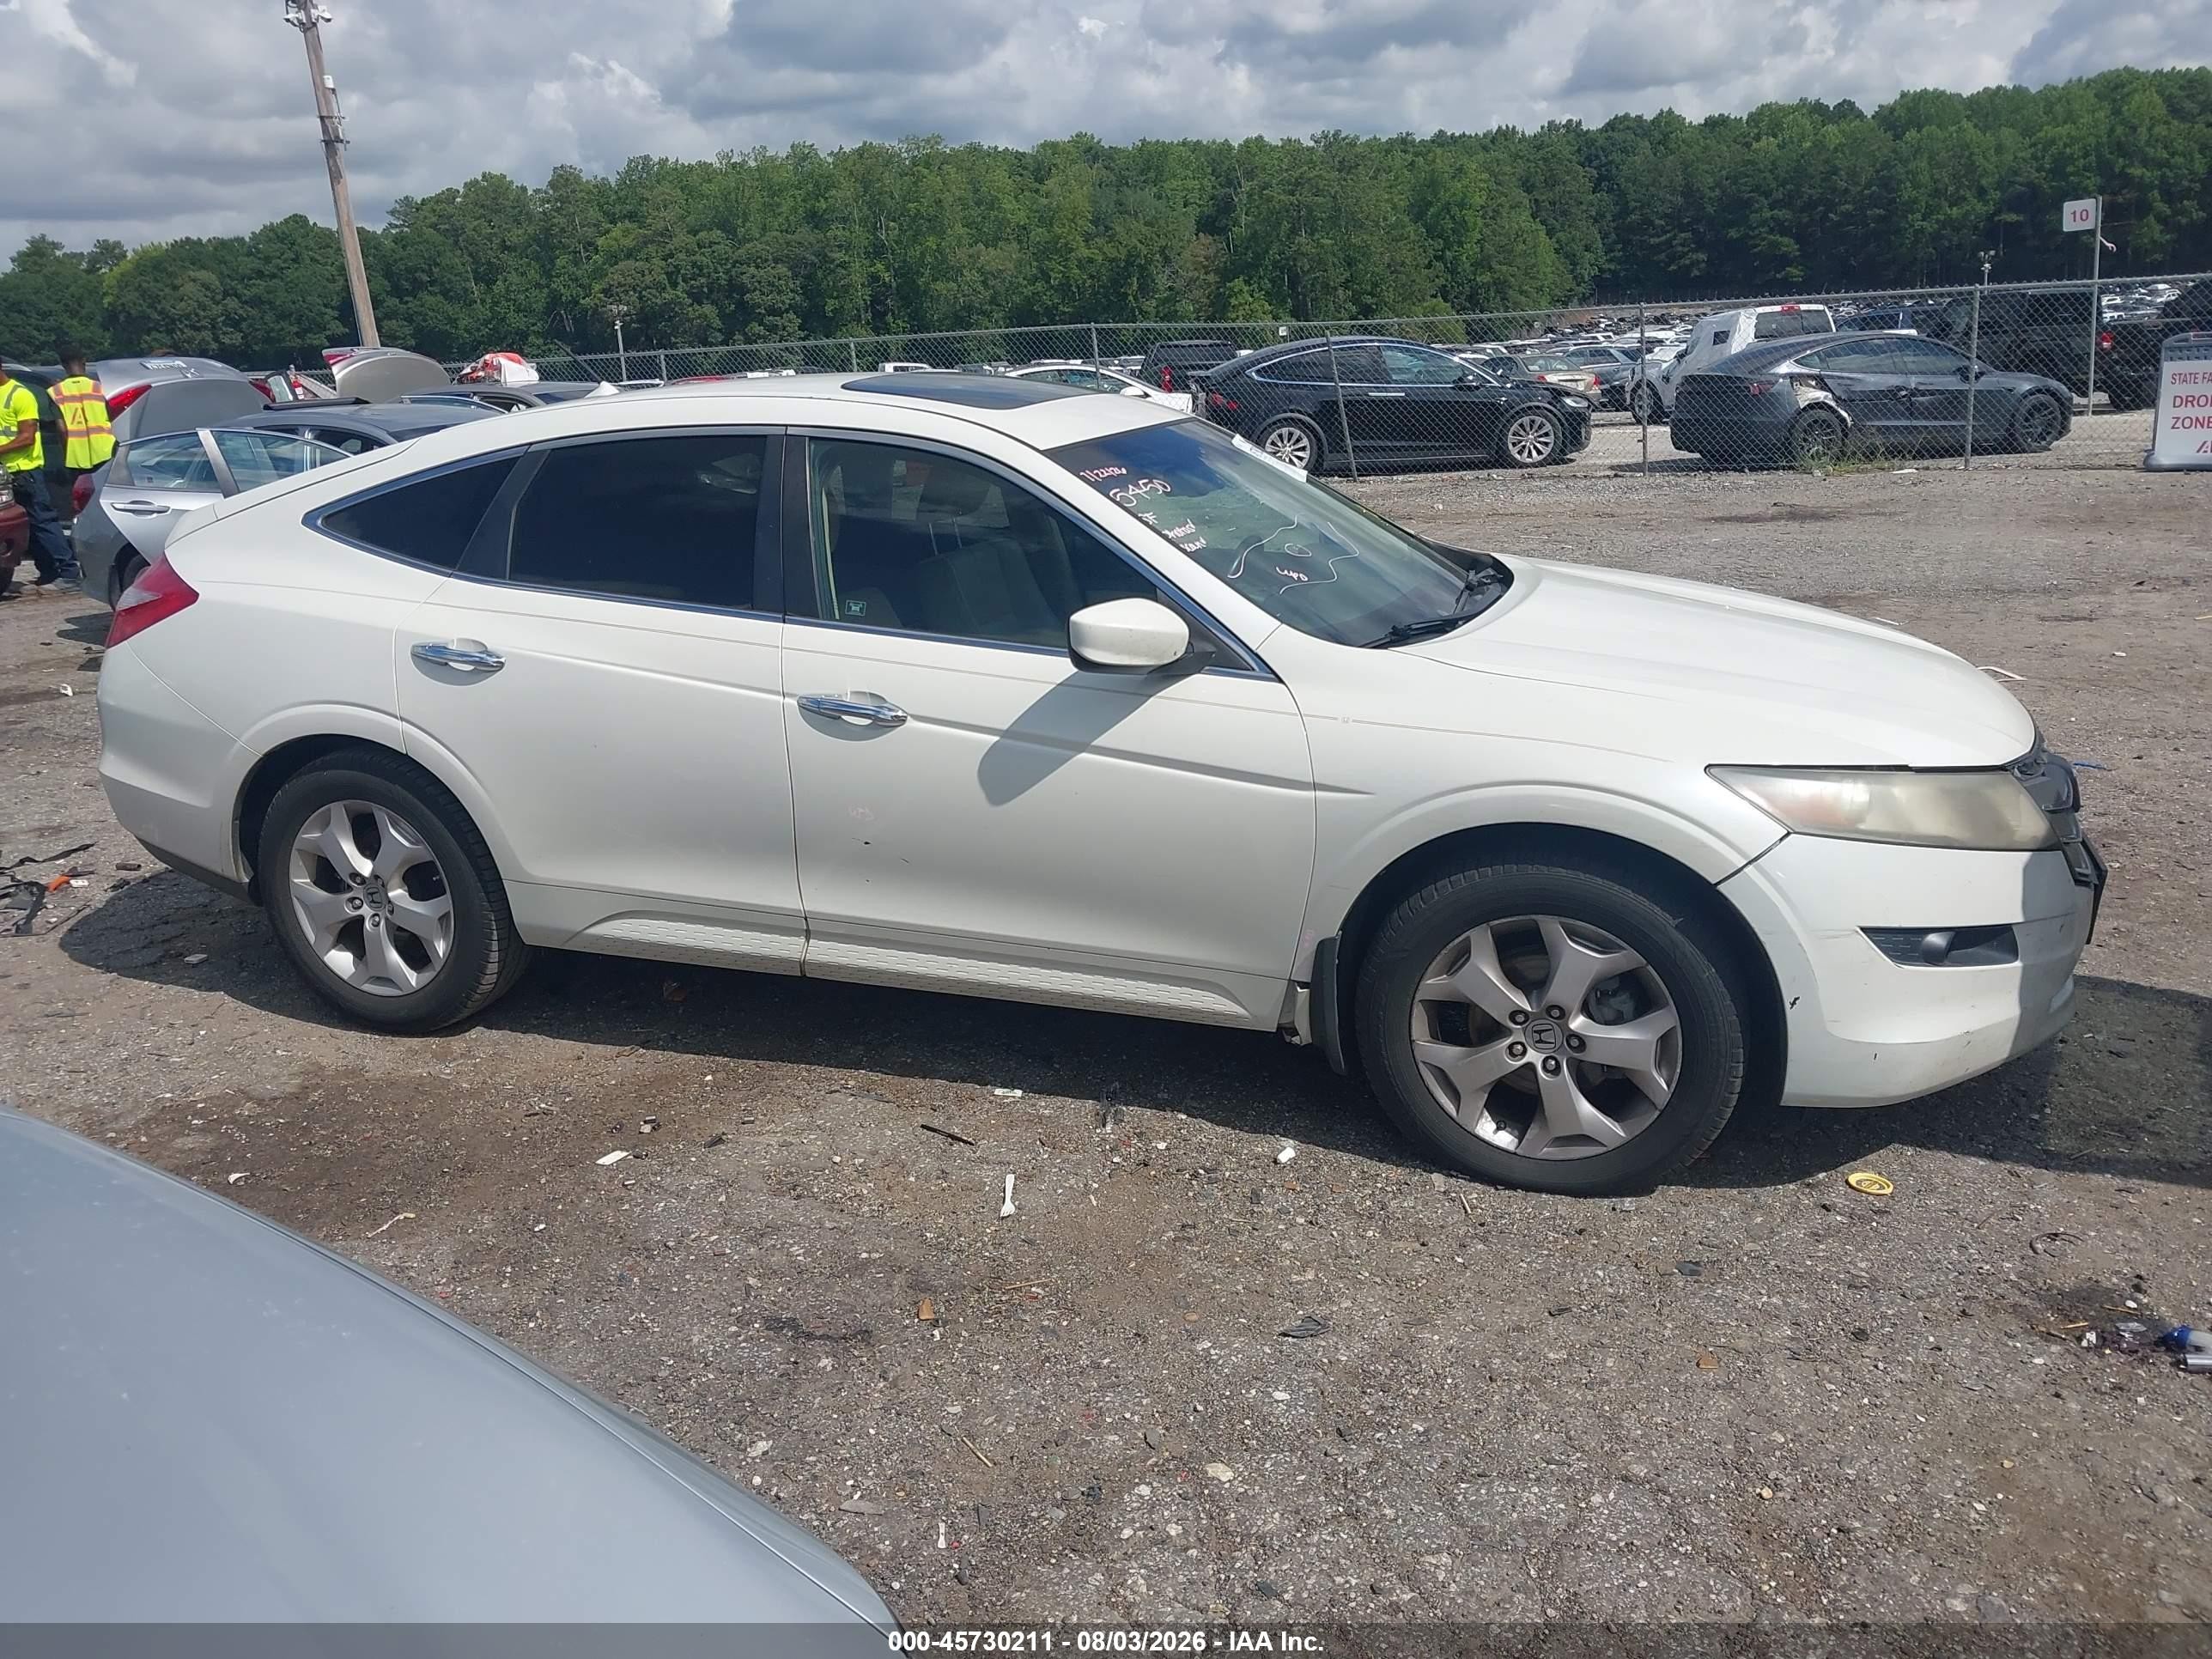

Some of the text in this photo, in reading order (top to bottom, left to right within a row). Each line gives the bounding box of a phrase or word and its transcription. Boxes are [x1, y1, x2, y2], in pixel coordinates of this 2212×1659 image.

[2070, 209, 2089, 222] 10
[2171, 372, 2200, 385] STATE
[2171, 416, 2212, 429] ZONE
[1109, 478, 1171, 507] 5450
